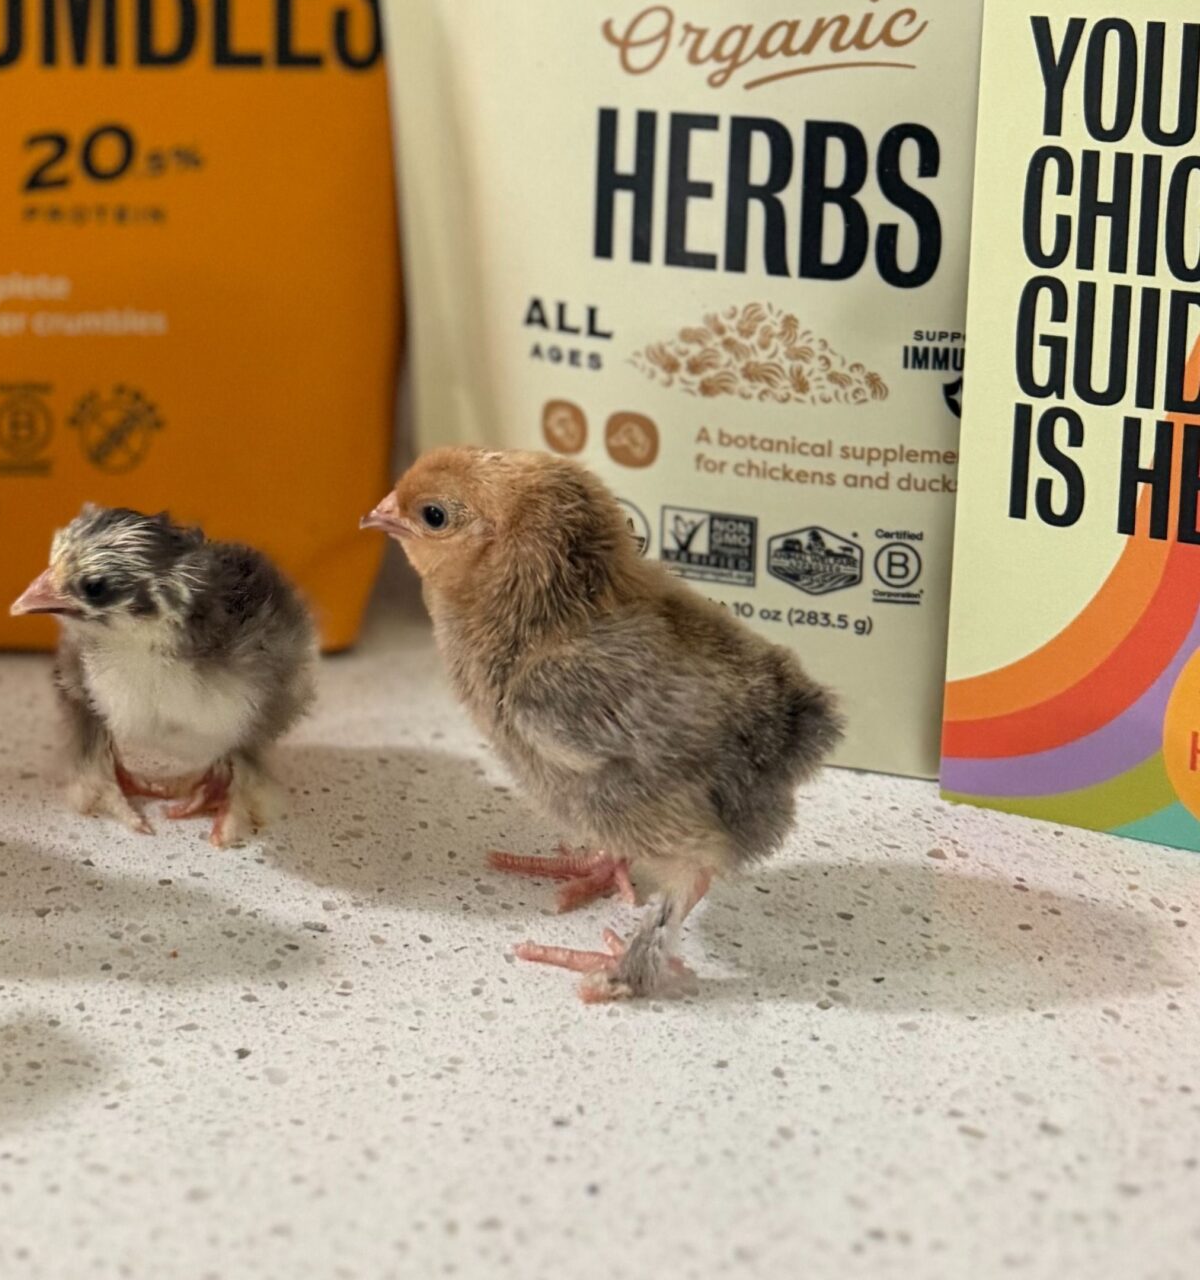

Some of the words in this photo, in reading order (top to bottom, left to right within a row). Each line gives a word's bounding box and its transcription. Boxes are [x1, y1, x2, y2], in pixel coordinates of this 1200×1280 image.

[593, 107, 942, 288] HERBS
[523, 297, 614, 339] ALL
[913, 330, 966, 343] SUPP
[530, 342, 603, 370] AGES
[695, 427, 712, 445] A
[718, 427, 832, 459] botanical
[839, 442, 959, 468] suppleme
[695, 453, 726, 474] for
[733, 458, 837, 488] chickens
[844, 468, 890, 493] and
[1008, 402, 1085, 528] IS
[712, 531, 750, 548] GMO
[714, 519, 750, 535] NON
[875, 528, 924, 541] Certified
[732, 602, 754, 618] 10
[760, 607, 782, 622] oz
[787, 606, 848, 630] (283.5
[853, 614, 874, 636] g)
